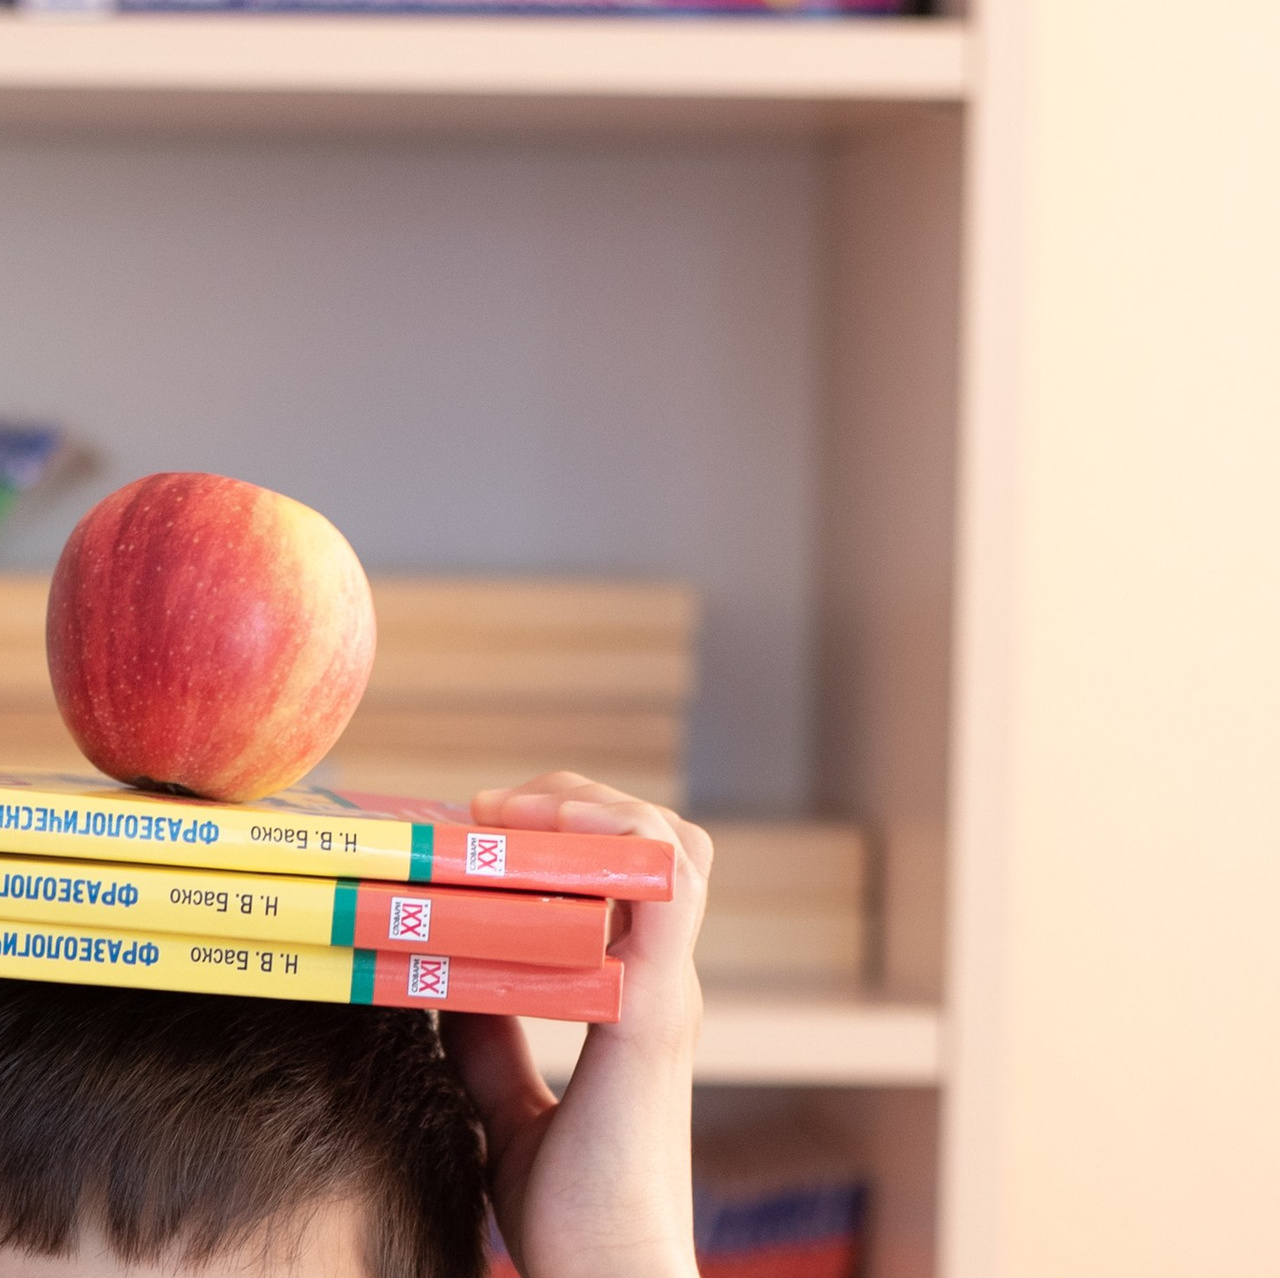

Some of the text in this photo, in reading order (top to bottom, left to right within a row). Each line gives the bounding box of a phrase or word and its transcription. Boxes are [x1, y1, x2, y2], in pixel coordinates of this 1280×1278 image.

[251, 826, 308, 849] Баско
[315, 830, 333, 851] В.
[339, 831, 357, 853] Н.
[477, 839, 498, 871] XXI
[170, 888, 228, 912] Баско
[235, 893, 253, 914] В.
[260, 894, 278, 916] Н.
[392, 901, 400, 936] СЛОВАРИ
[400, 903, 423, 937] XXI
[190, 946, 249, 970] Баско
[255, 950, 273, 972] В.
[280, 952, 298, 974] Н.
[411, 958, 419, 993] СЛОВАРИ
[419, 960, 442, 994] XXI
